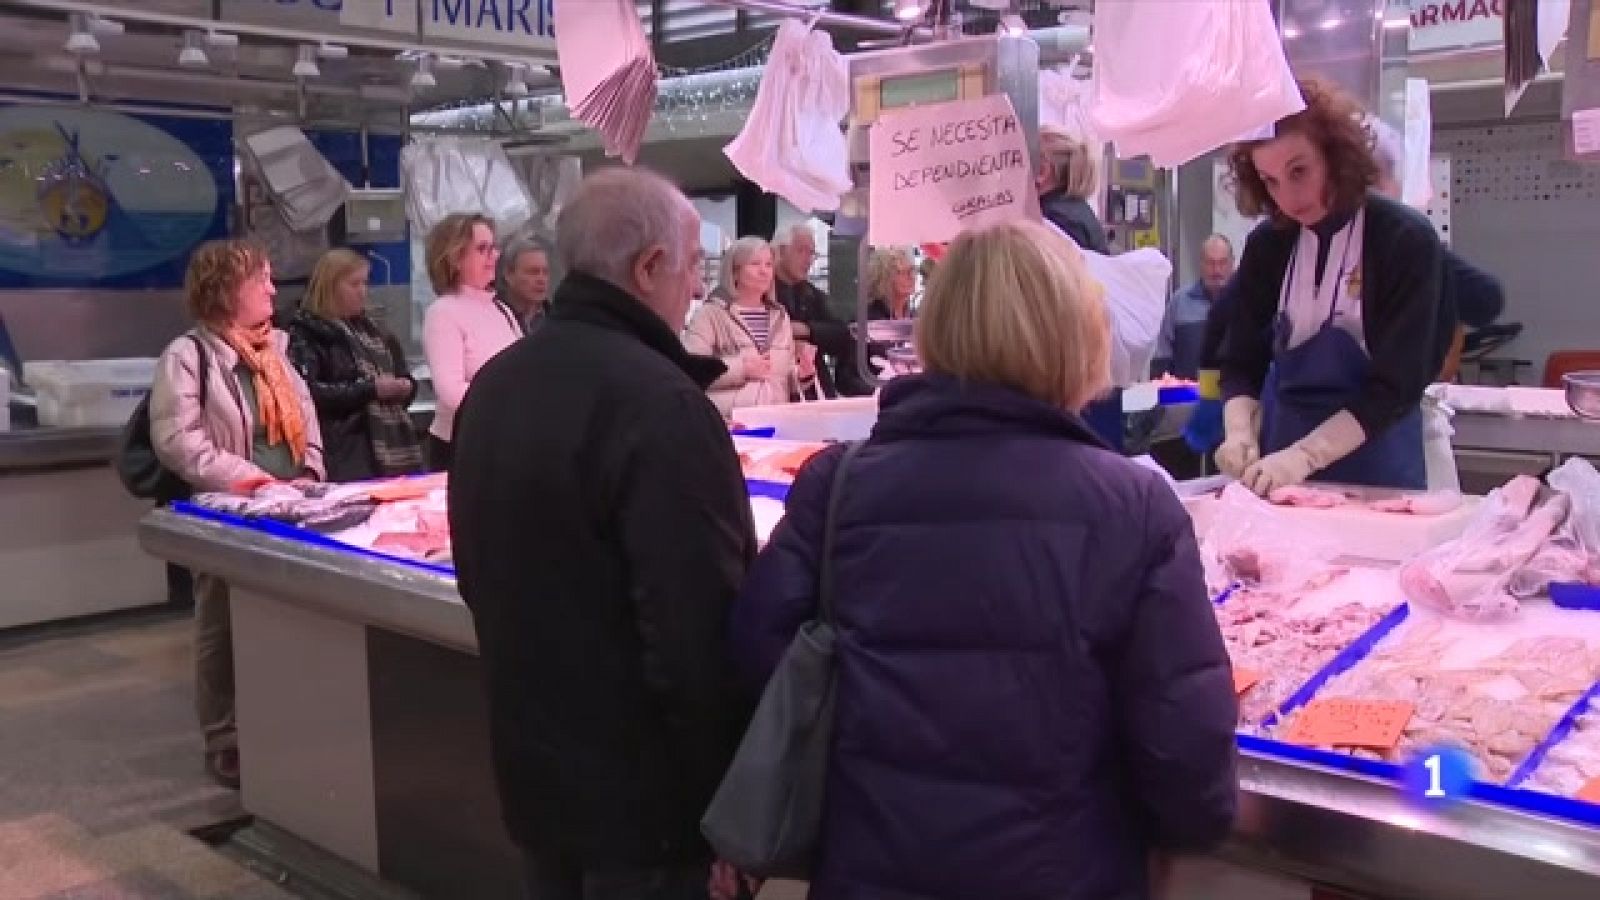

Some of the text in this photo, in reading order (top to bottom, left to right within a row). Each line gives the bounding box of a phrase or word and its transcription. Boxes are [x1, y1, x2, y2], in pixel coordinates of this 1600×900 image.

[891, 114, 1016, 157] SE NECESITA
[894, 149, 1025, 190] DEPENDIENTA
